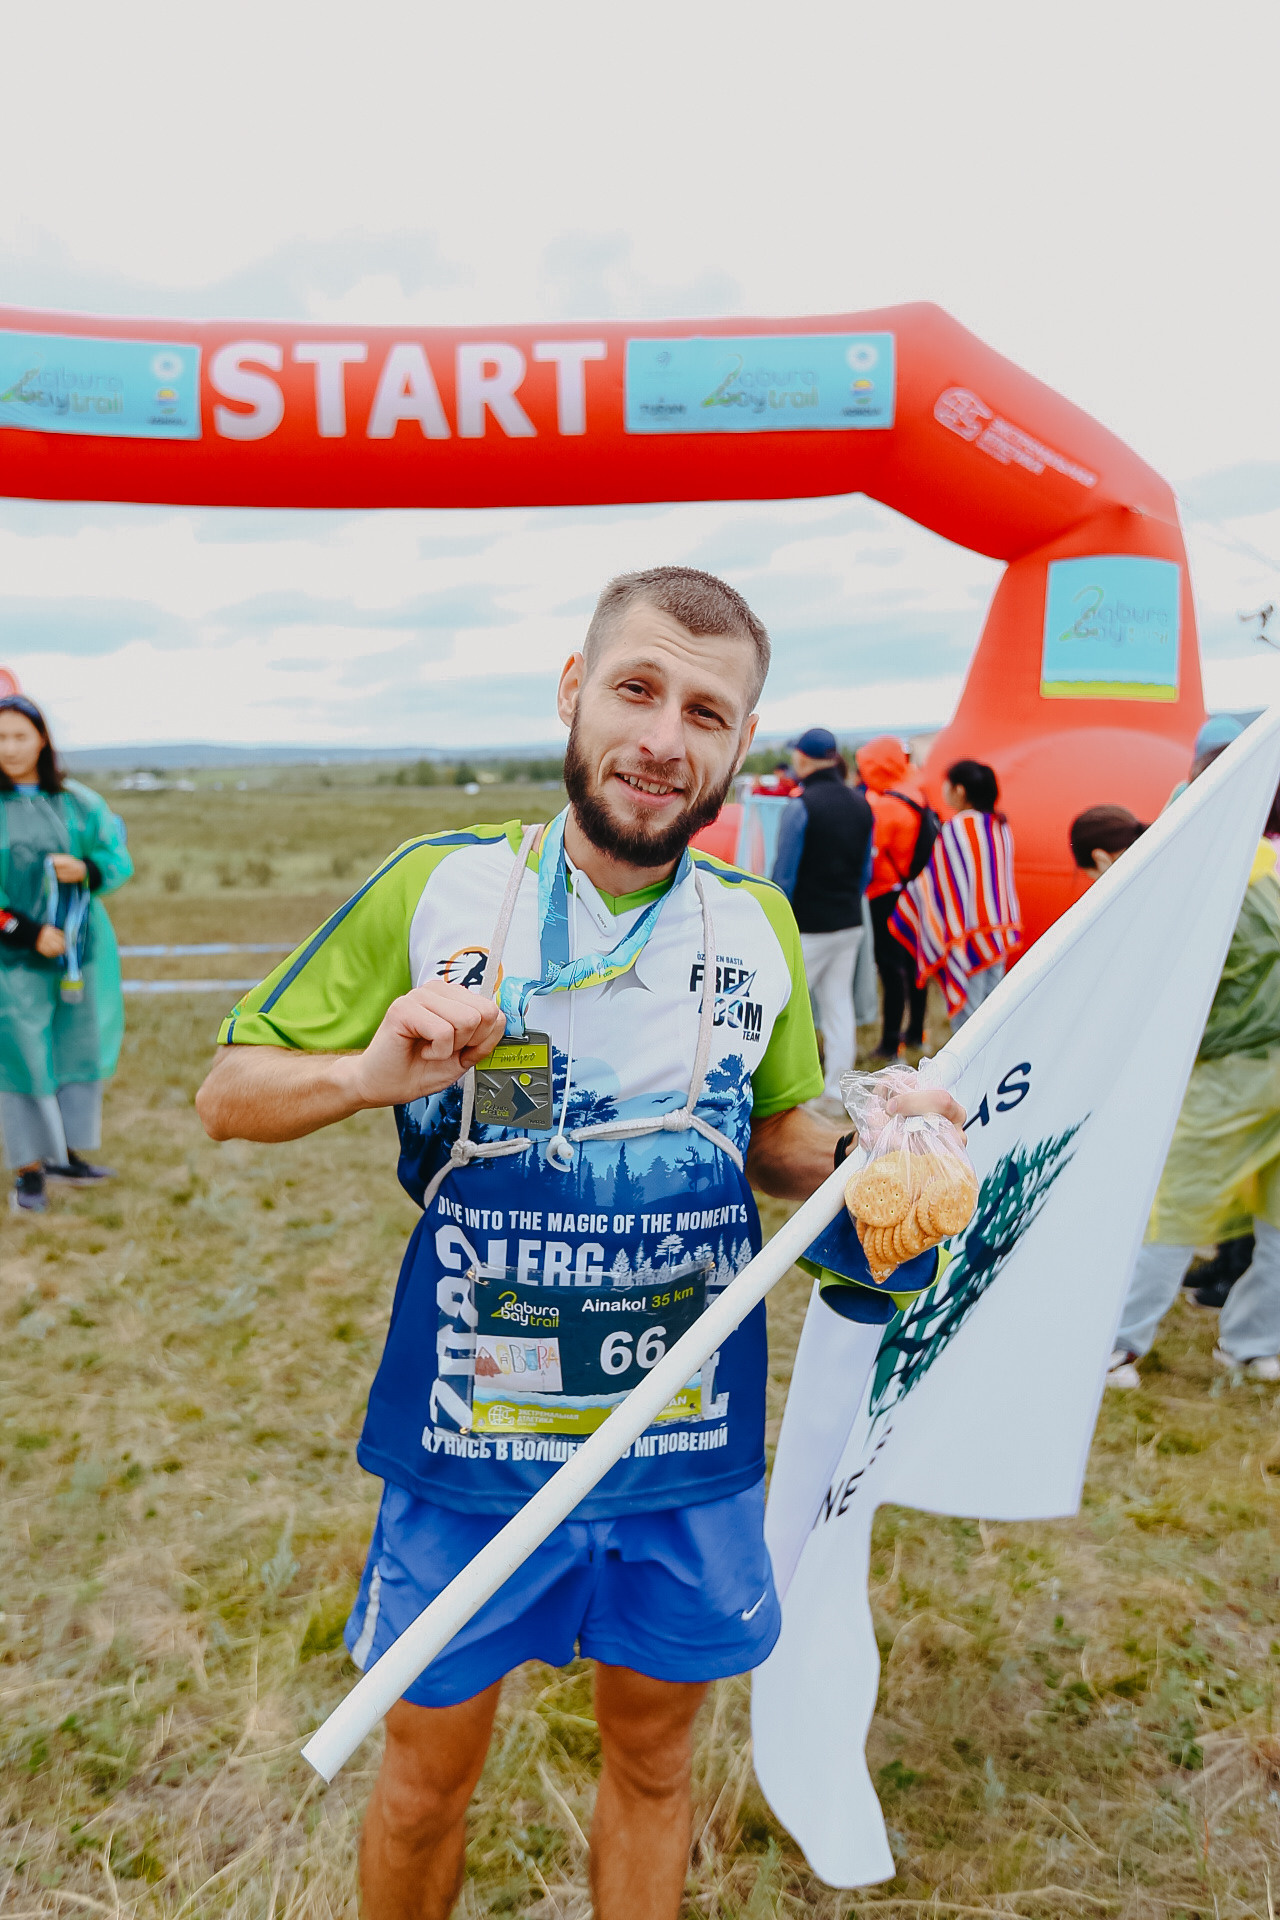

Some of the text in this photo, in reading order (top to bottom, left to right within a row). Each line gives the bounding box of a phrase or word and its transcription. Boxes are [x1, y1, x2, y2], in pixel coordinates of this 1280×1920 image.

[210, 342, 608, 440] START
[725, 957, 744, 966] BASTA
[743, 1030, 761, 1042] TEAM
[464, 1207, 503, 1231] INTO
[508, 1210, 543, 1231] THE
[547, 1212, 608, 1234] MAGIC
[612, 1214, 636, 1234] OF
[640, 1213, 672, 1234] THE
[675, 1203, 748, 1232] MOMENTS
[581, 1286, 694, 1313] Ainakol 35 km
[500, 1306, 560, 1328] bay trail
[518, 1408, 579, 1420] ЭКСТРЕМАЛЬНАЯ
[495, 1439, 509, 1461] В
[634, 1422, 728, 1458] МГНОВЕНИЙ
